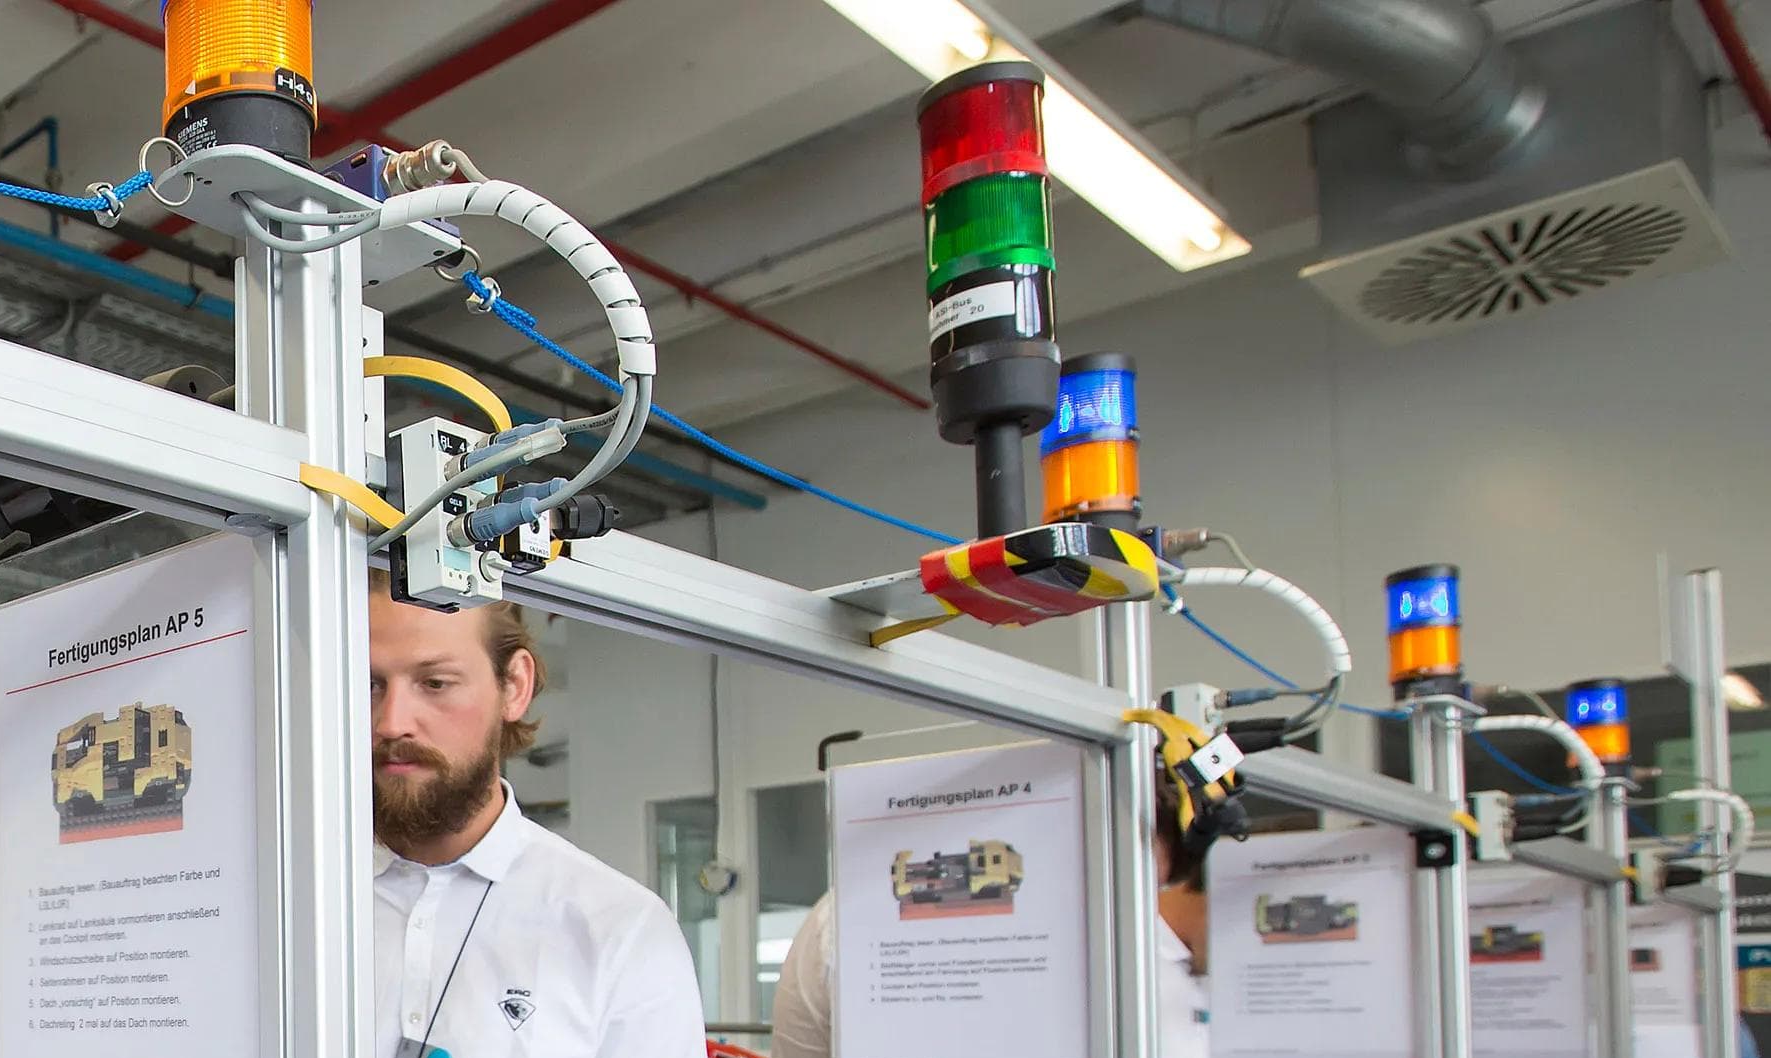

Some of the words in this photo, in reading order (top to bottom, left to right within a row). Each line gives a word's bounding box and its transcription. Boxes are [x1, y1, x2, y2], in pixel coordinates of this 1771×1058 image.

[48, 624, 161, 668] Fertigungsplan
[165, 611, 189, 636] AP
[194, 607, 205, 628] 5
[888, 788, 994, 809] Fertigungsplan
[998, 783, 1019, 797] AP
[1023, 781, 1032, 794] 4
[142, 873, 178, 886] beachten
[180, 870, 203, 882] Farbe
[205, 868, 220, 879] und
[167, 906, 220, 920] anschließend
[106, 953, 118, 963] auf
[119, 950, 148, 962] Position
[88, 974, 99, 985] auf
[100, 973, 129, 985] Position
[506, 988, 531, 998] ERC
[40, 998, 57, 1008] Dach
[98, 996, 109, 1006] auf
[111, 996, 139, 1006] Position
[79, 1019, 84, 1029] 2
[85, 1018, 99, 1028] mal
[100, 1018, 112, 1028] auf
[113, 1018, 127, 1028] das
[128, 1017, 147, 1028] Dach
[149, 1017, 189, 1028] montieren.
